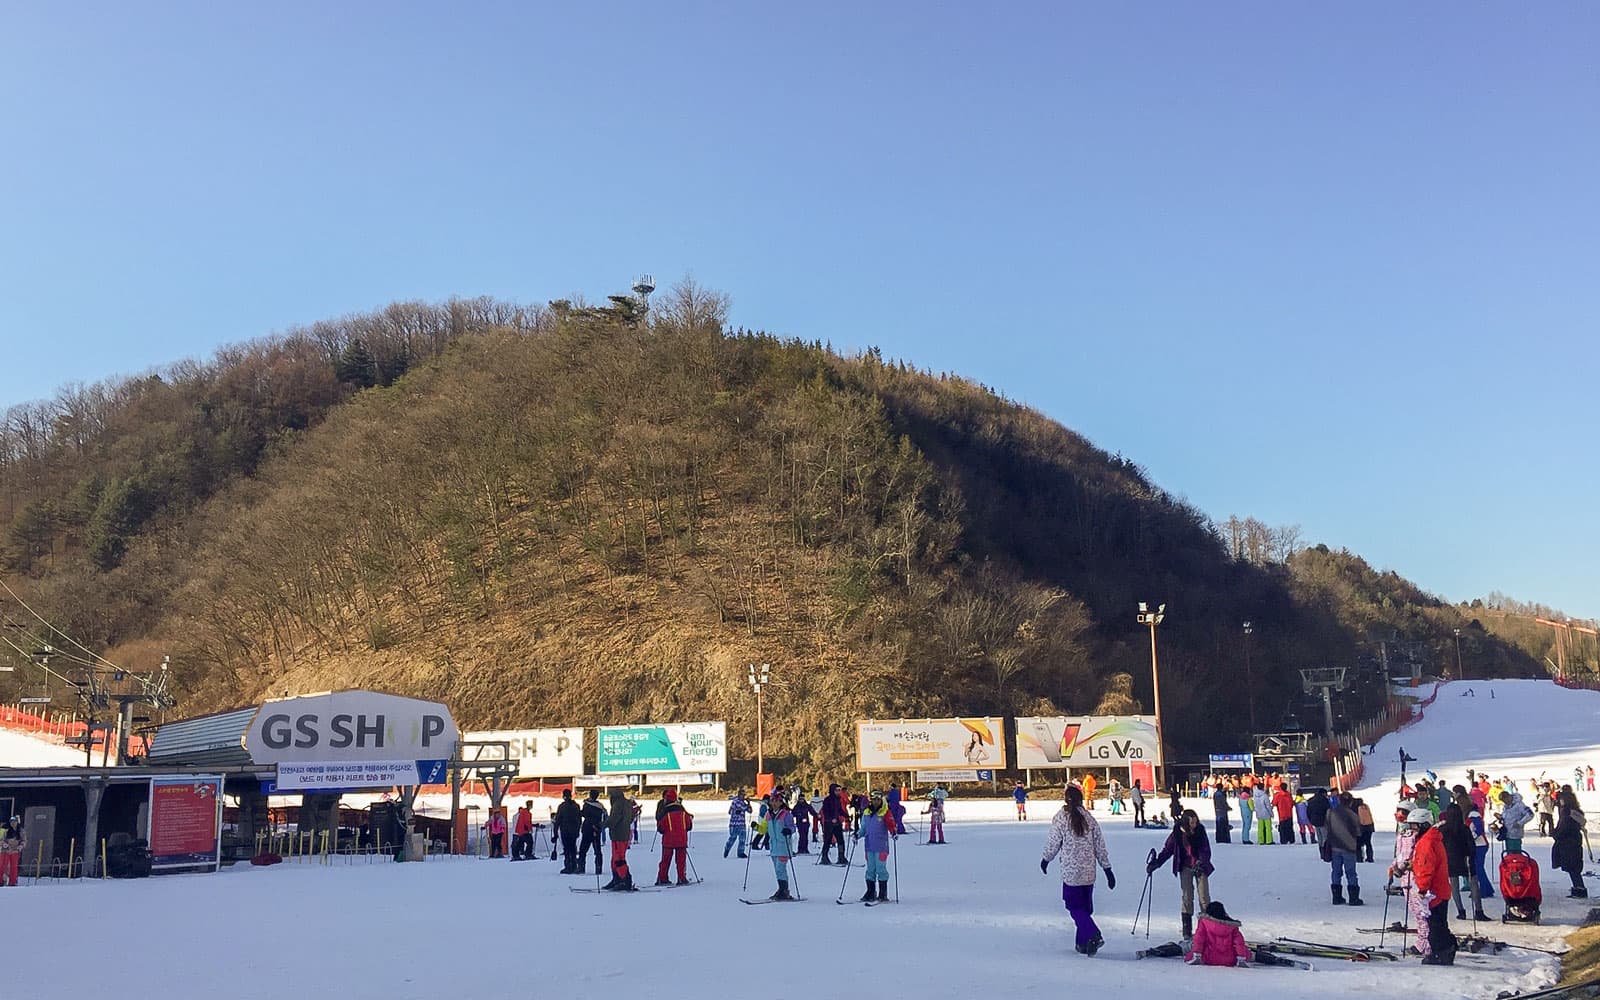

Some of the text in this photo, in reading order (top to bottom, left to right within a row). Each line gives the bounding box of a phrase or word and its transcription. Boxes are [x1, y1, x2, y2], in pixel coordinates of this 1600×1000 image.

[261, 714, 319, 749] GS
[690, 740, 711, 748] your
[682, 746, 718, 756] Energy
[1088, 740, 1143, 759] LG V20
[280, 766, 305, 774] 안전사고
